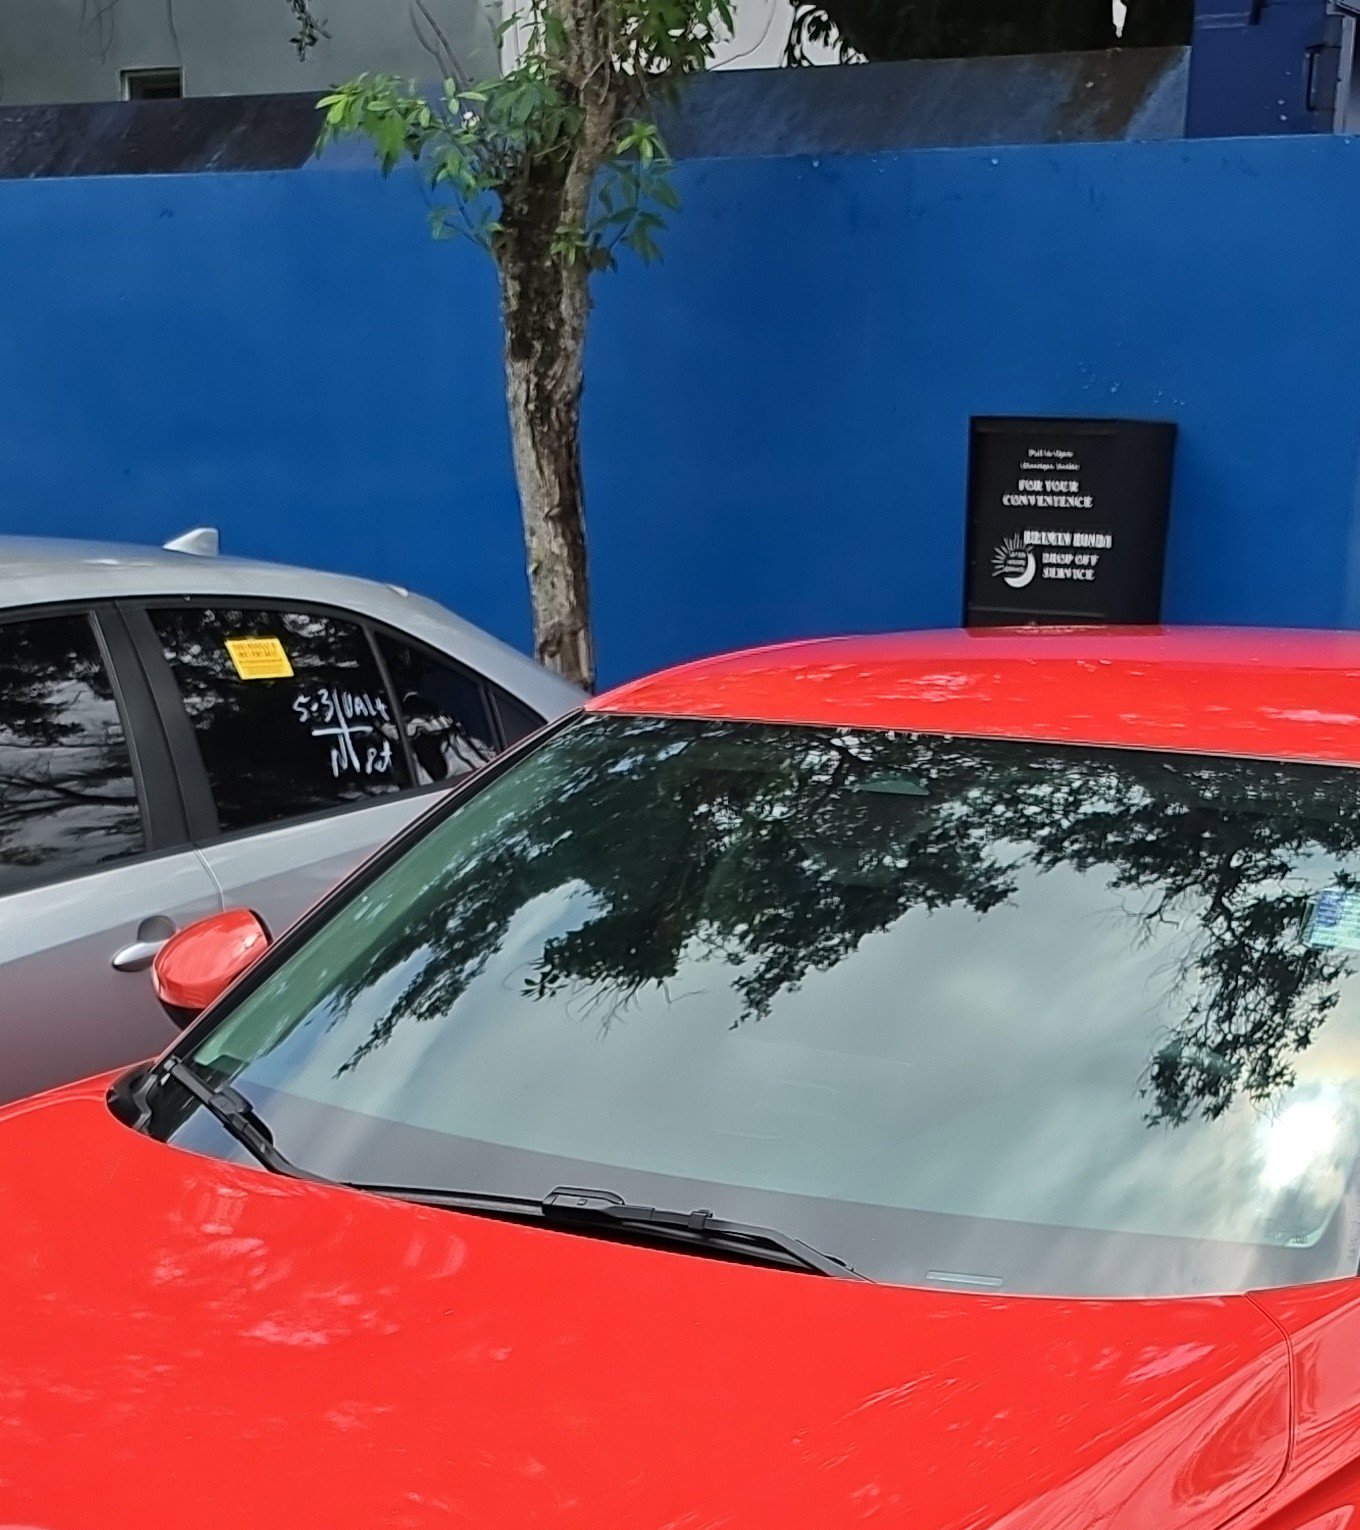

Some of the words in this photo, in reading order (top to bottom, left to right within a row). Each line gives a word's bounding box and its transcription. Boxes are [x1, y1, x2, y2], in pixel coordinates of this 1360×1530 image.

[1017, 479, 1044, 492] FOR
[1044, 480, 1080, 493] YOUR
[1002, 494, 1094, 508] CONVENIENCE
[1041, 552, 1074, 565] DROP
[1074, 553, 1100, 566] OFF
[1041, 566, 1096, 580] SERVICE
